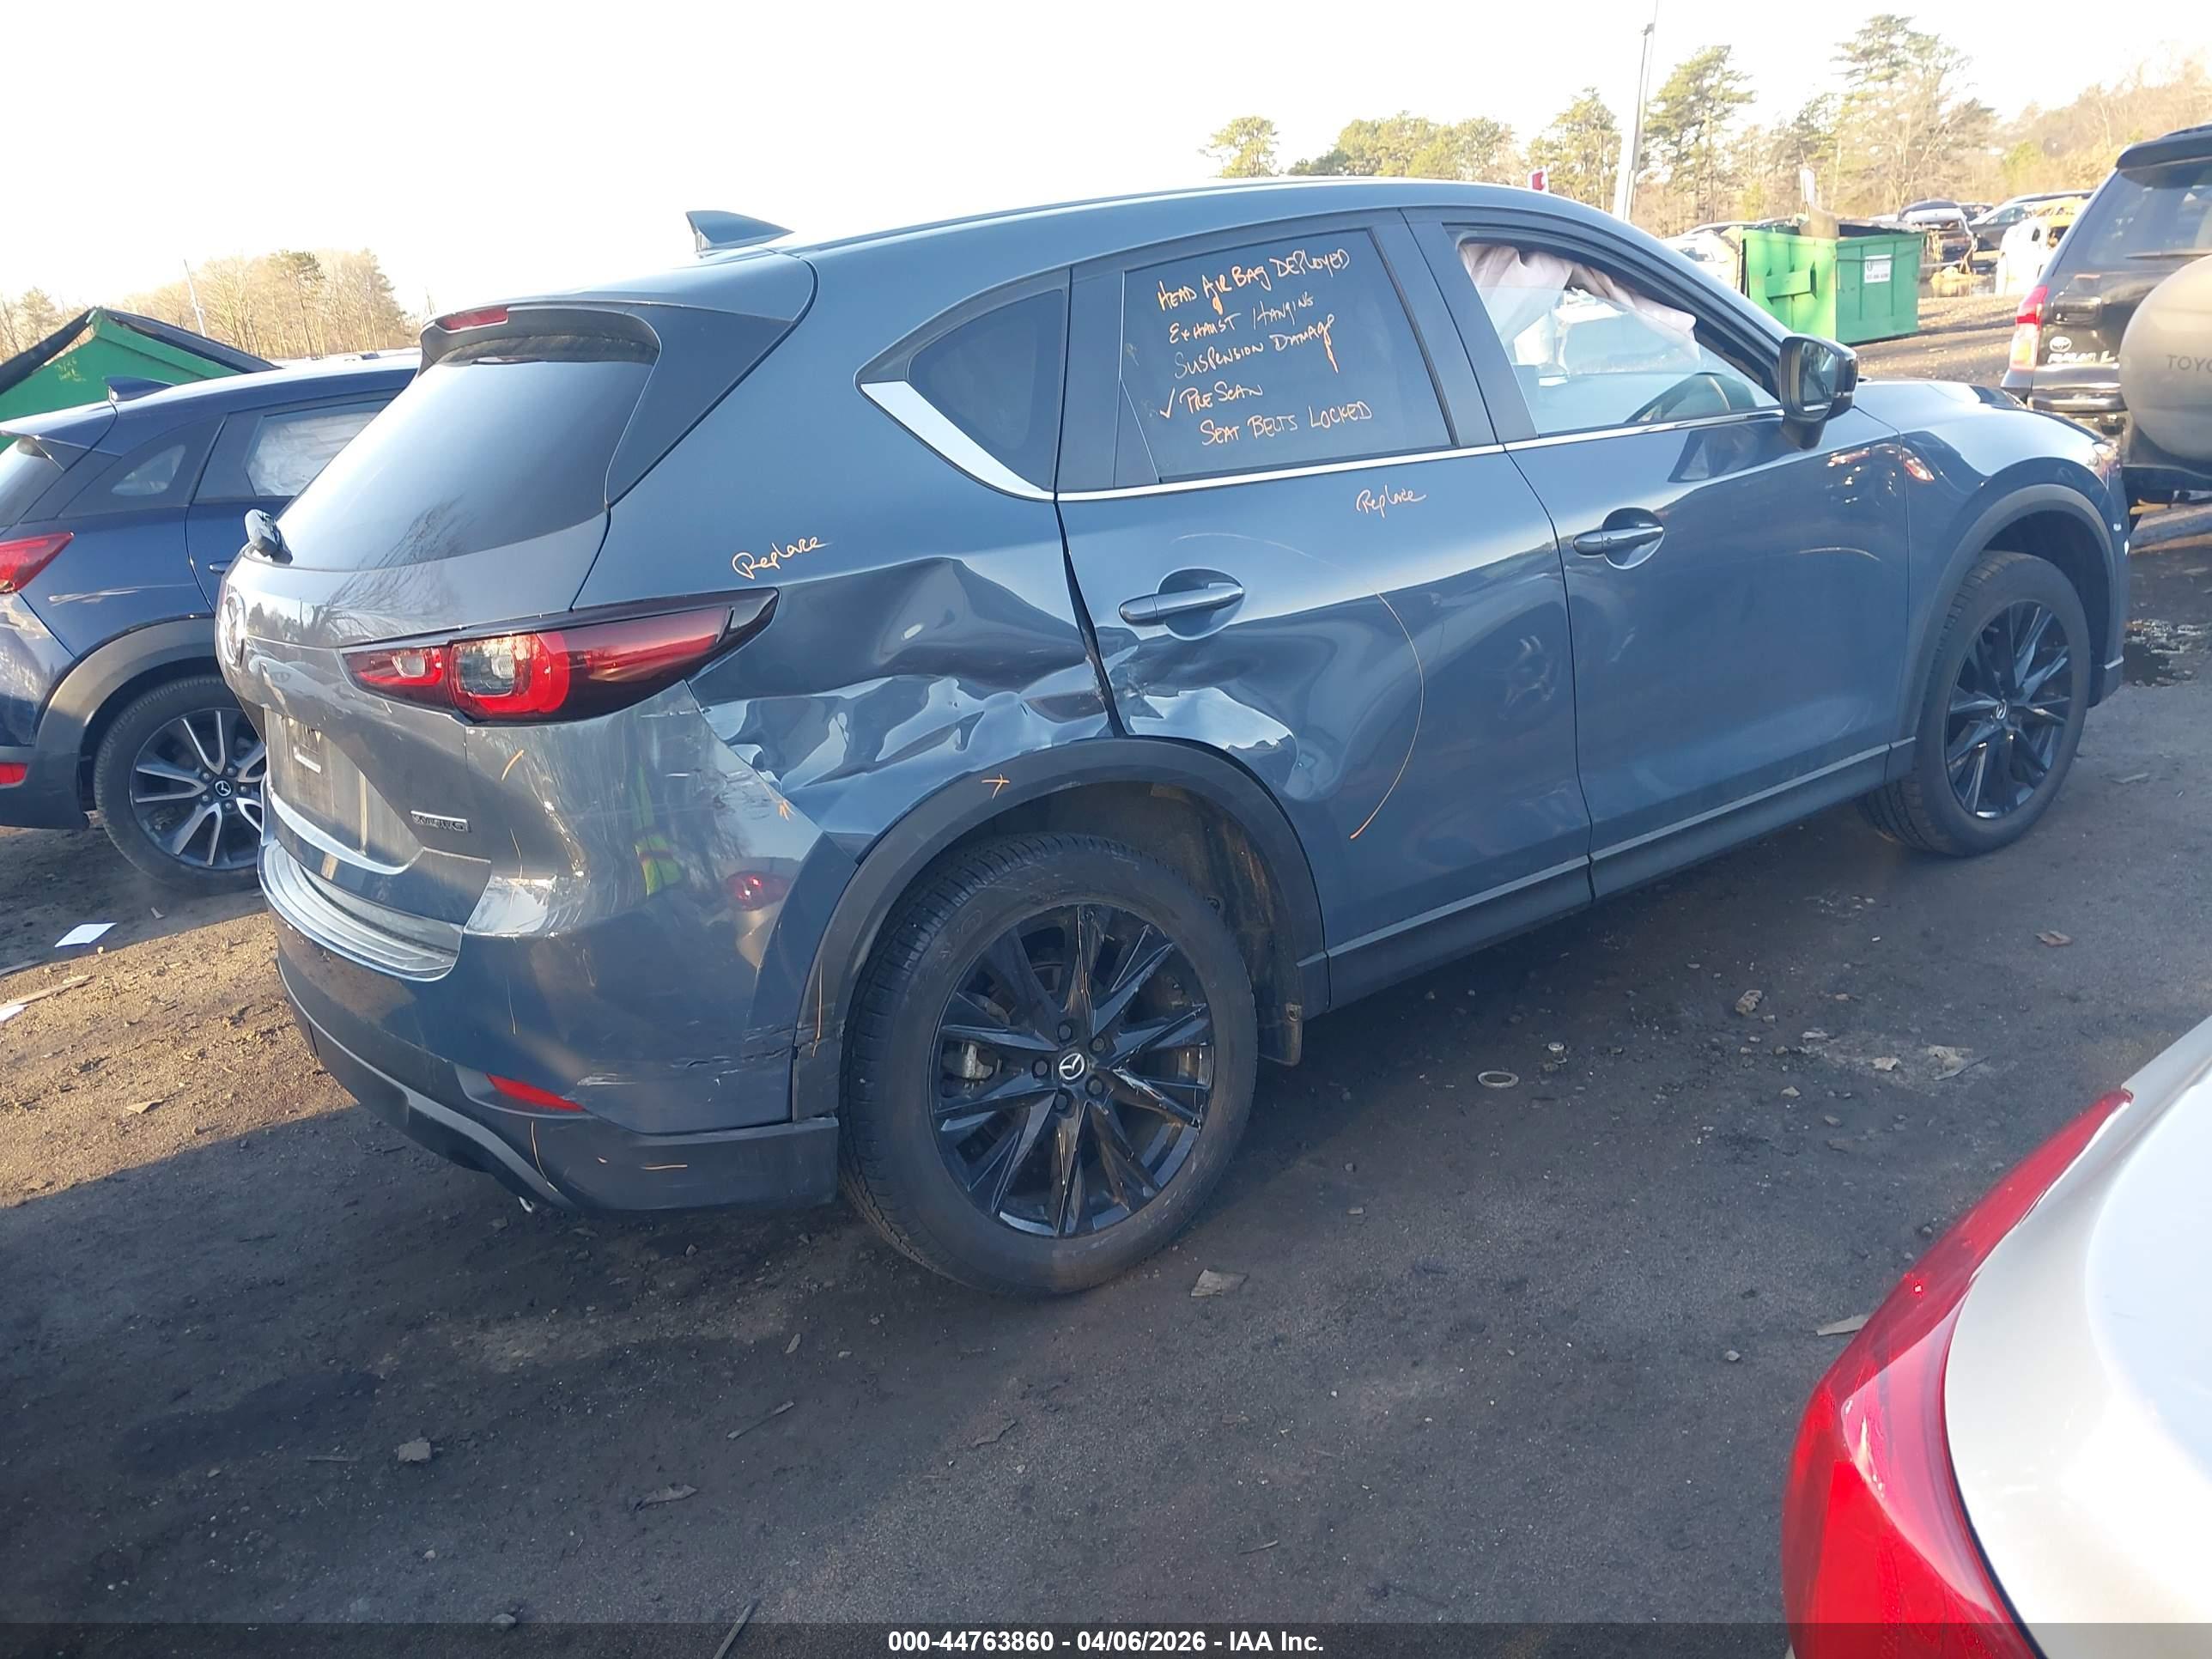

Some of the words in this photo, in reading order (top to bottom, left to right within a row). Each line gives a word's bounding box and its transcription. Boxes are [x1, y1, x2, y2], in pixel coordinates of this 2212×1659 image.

[1157, 281, 1197, 311] HEAD
[1201, 274, 1232, 315] AIR
[1200, 419, 1240, 446] SEAT
[1247, 415, 1298, 439] BELTS
[1308, 400, 1373, 428] LOCKED
